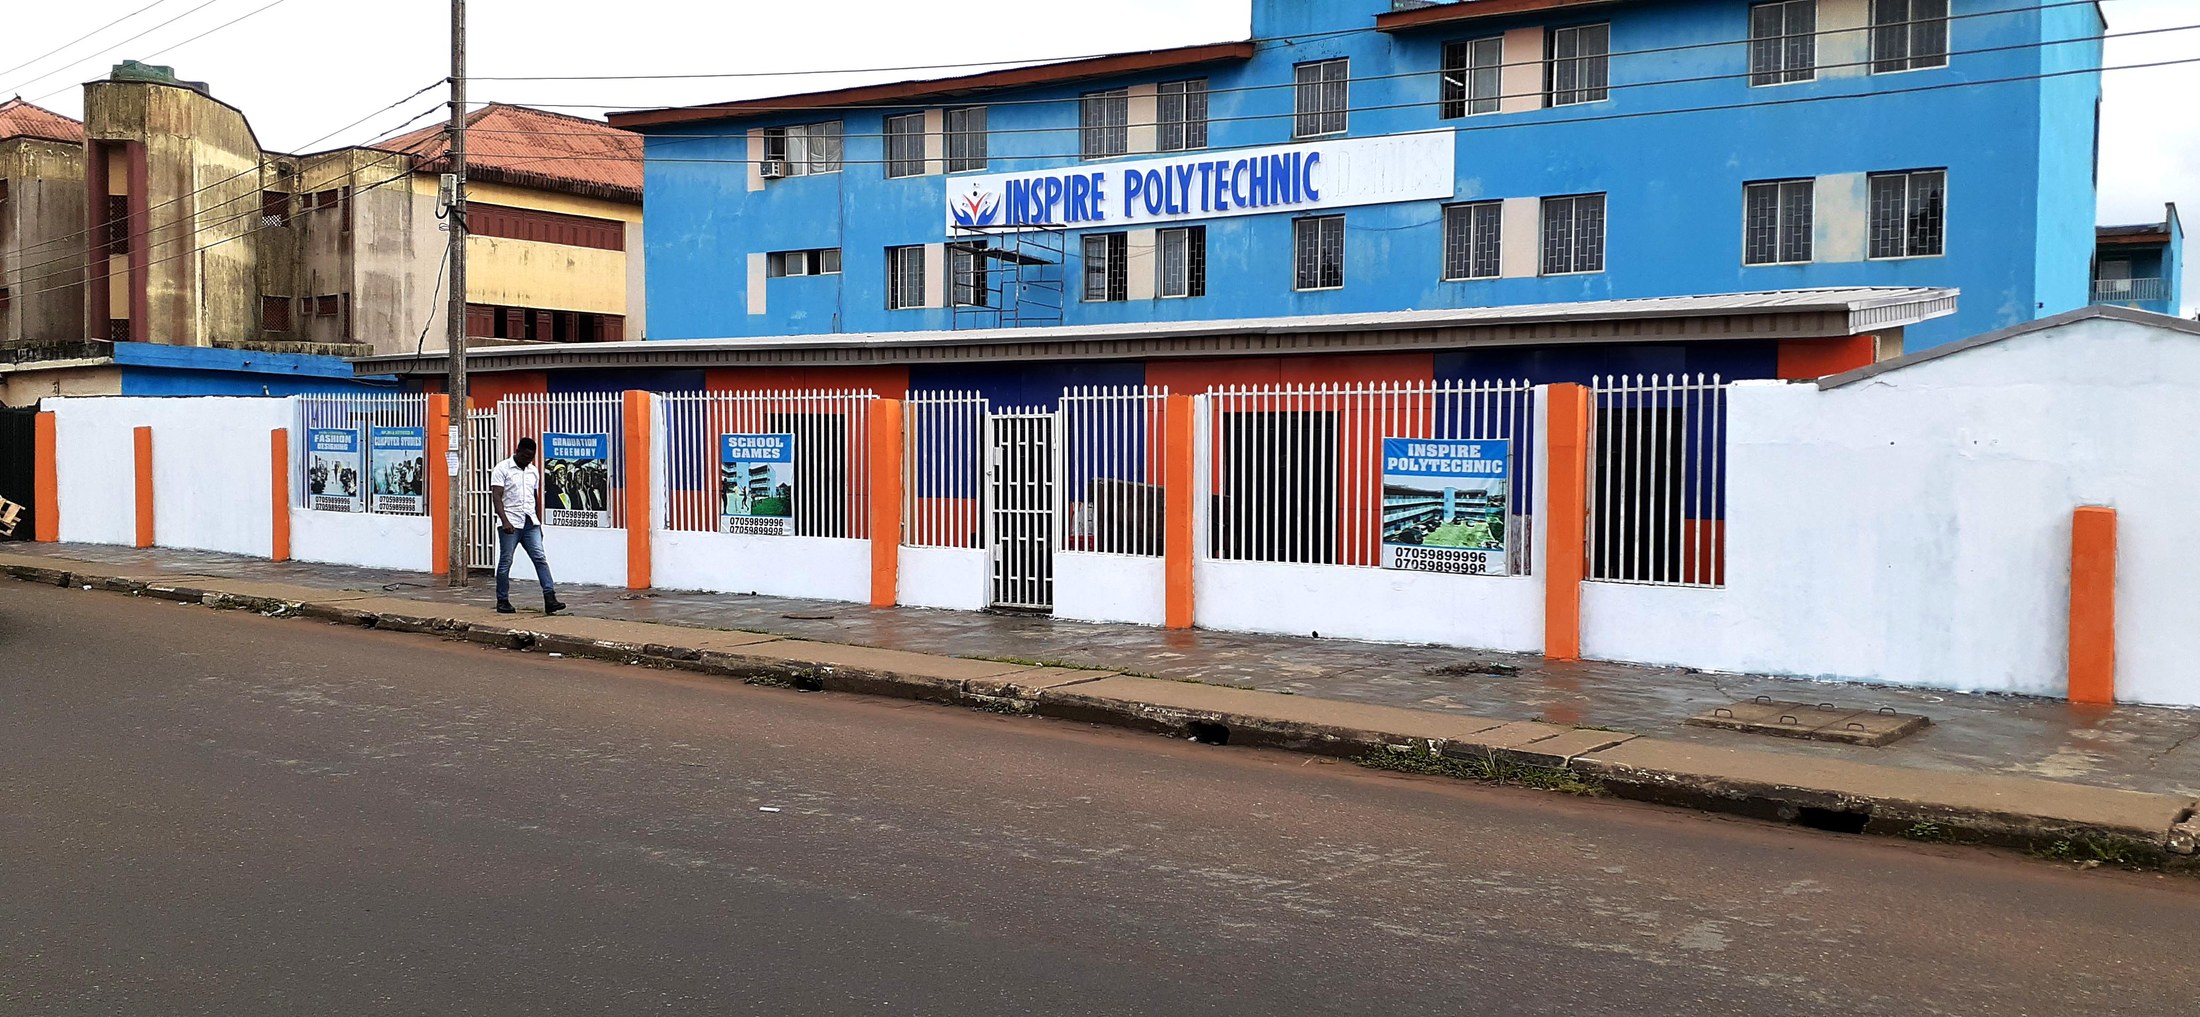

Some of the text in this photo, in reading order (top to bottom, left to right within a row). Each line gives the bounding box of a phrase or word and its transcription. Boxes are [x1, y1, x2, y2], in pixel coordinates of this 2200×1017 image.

[1005, 172, 1106, 225] INSPIRE
[1124, 151, 1321, 218] POLYTECHNIC
[314, 434, 352, 443] FASHION
[374, 436, 422, 446] COMPUTER STUDIES
[552, 437, 598, 447] GRADUATION
[728, 437, 784, 448] SCHOOL
[554, 447, 597, 457] CEREMONY
[732, 448, 781, 459] GAMES
[1407, 443, 1481, 458] INSPIRE
[1387, 457, 1503, 474] POLYTECHNIC
[315, 496, 351, 505] 07059899996
[379, 496, 416, 504] 07059899996
[379, 503, 416, 511] 07059899998
[552, 509, 598, 519] 07059899996
[552, 518, 598, 527] 07059899998
[730, 517, 784, 527] 07059899996
[729, 525, 784, 536] 07059899998
[1395, 547, 1487, 563] 07059899996
[1395, 558, 1487, 574] 07059899998
